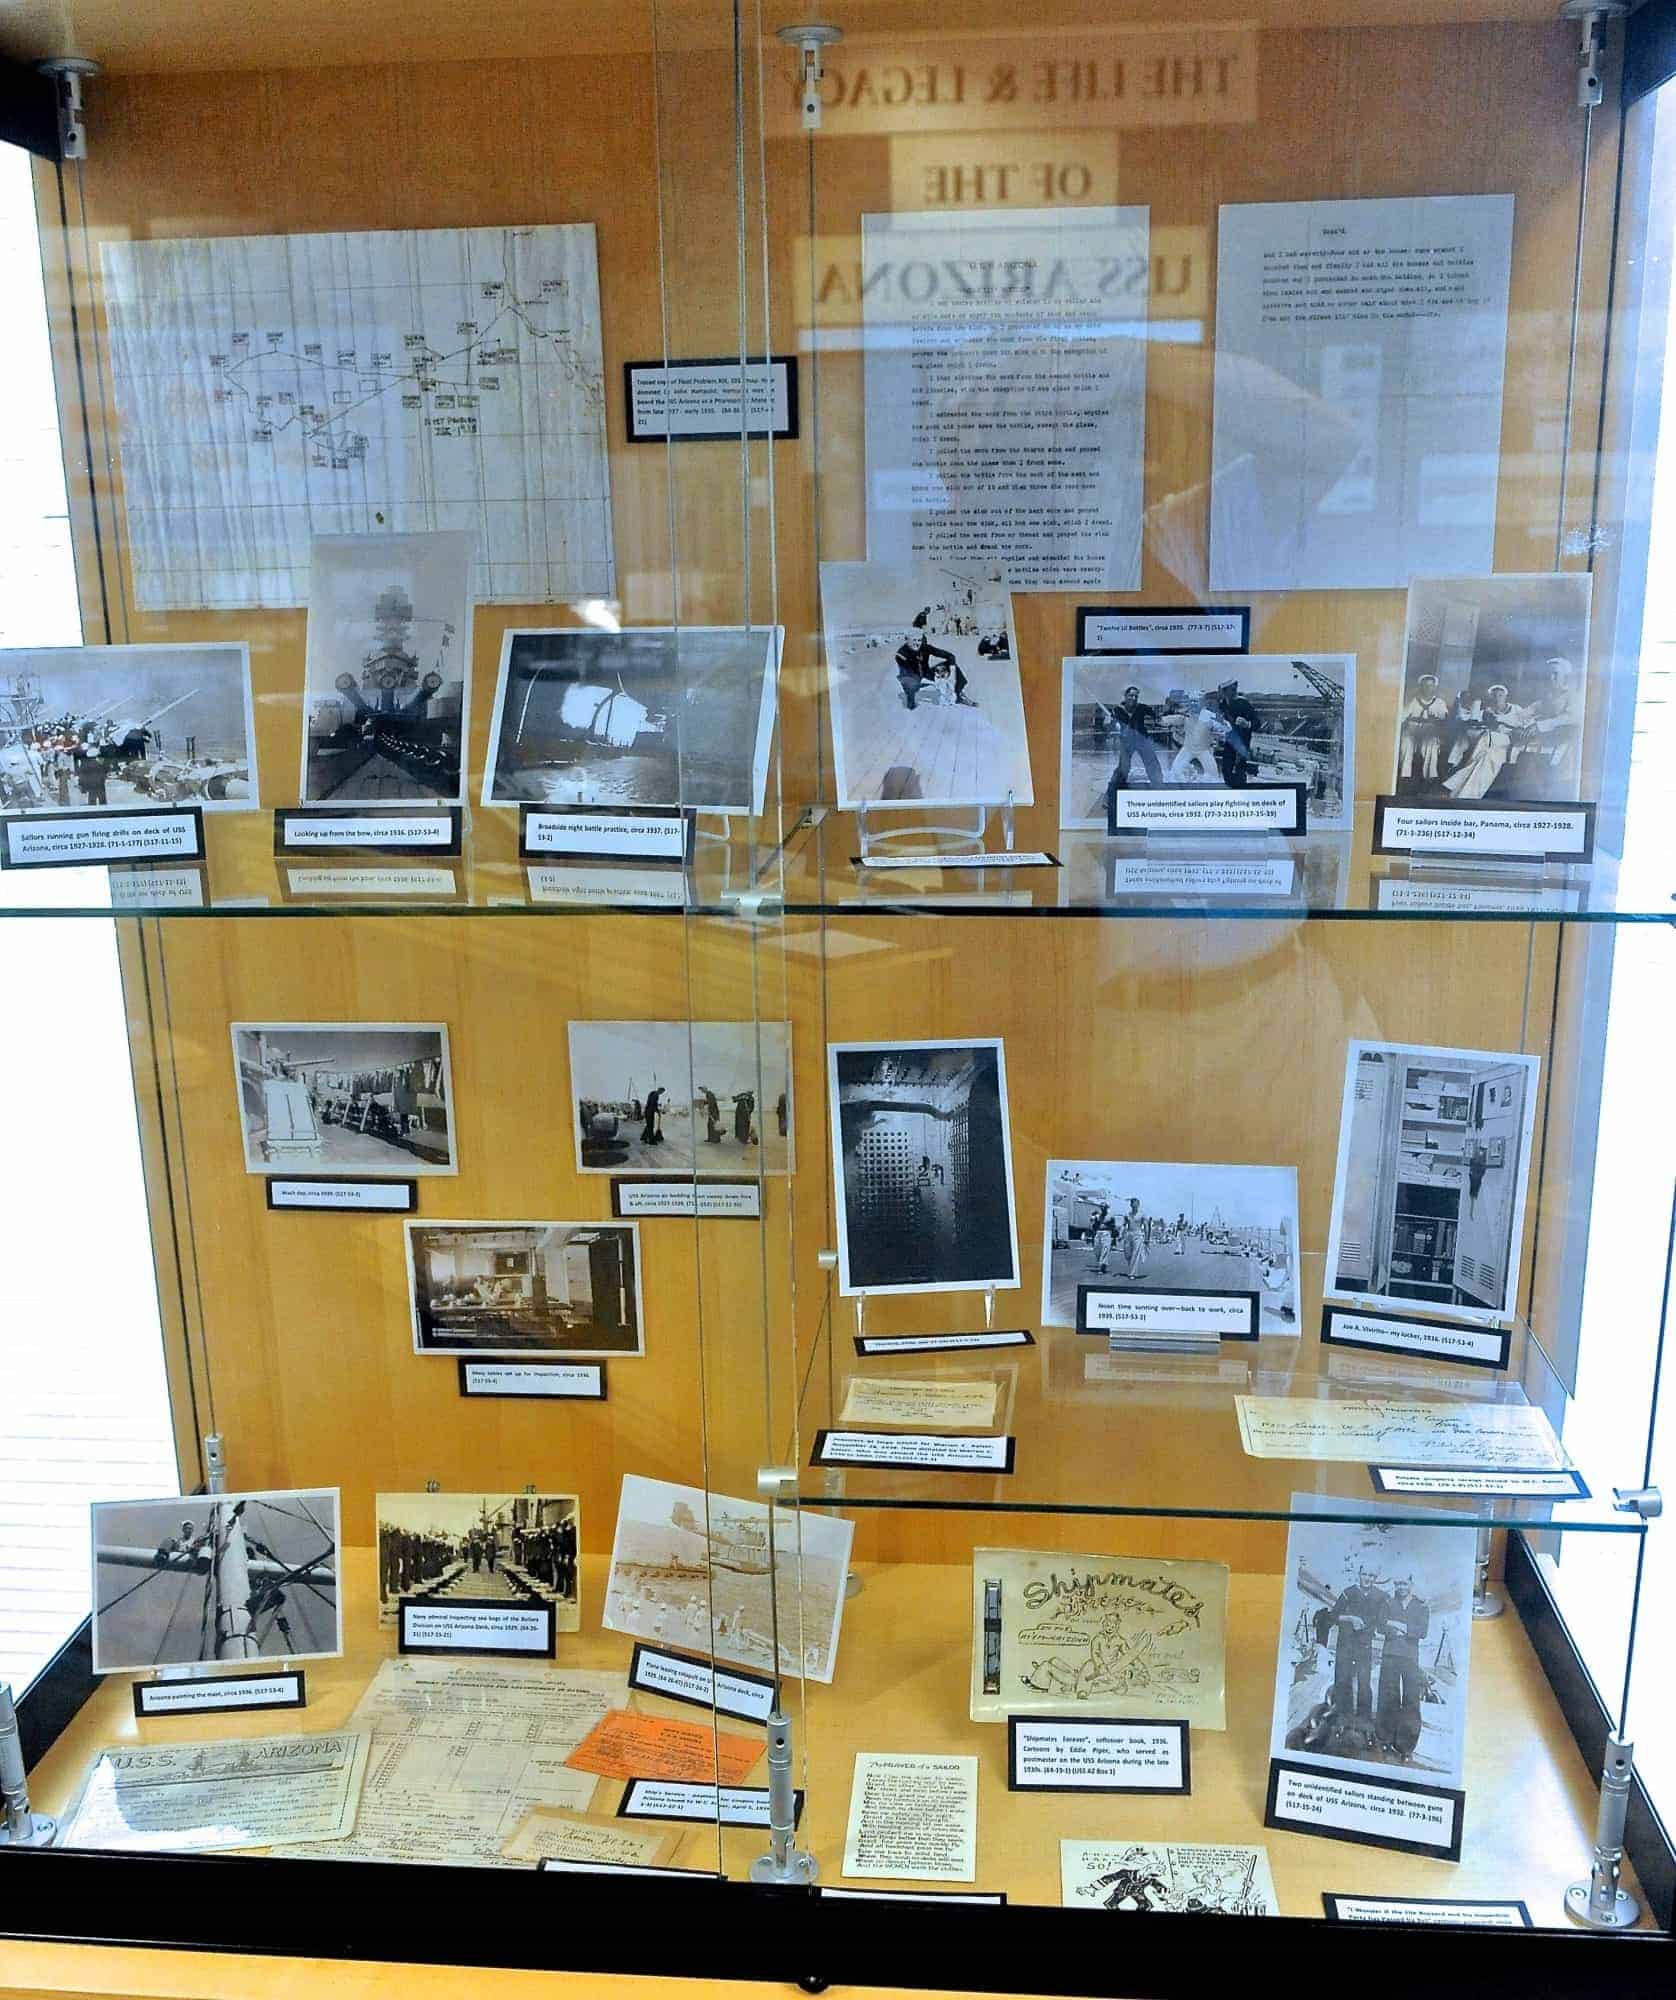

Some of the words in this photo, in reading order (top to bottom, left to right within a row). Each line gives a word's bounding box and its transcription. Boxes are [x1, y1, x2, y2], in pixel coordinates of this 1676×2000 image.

[1209, 800, 1224, 808] play
[1225, 800, 1250, 808] fighting
[568, 824, 583, 832] night
[603, 825, 629, 834] practice,
[1463, 820, 1479, 828] bar,
[1480, 820, 1512, 829] Panama,
[47, 831, 74, 841] running
[92, 830, 110, 838] firing
[256, 1742, 343, 1760] ARIZONA
[1288, 1780, 1302, 1788] Two
[1303, 1782, 1342, 1794] unidentified
[1344, 1789, 1365, 1798] sailors
[1367, 1792, 1394, 1804] standing
[1397, 1797, 1426, 1808] between
[1427, 1804, 1443, 1812] guns
[1298, 1792, 1313, 1801] deck
[1325, 1797, 1338, 1805] USS
[1340, 1799, 1368, 1811] Arizona,
[1370, 1804, 1385, 1813] circa
